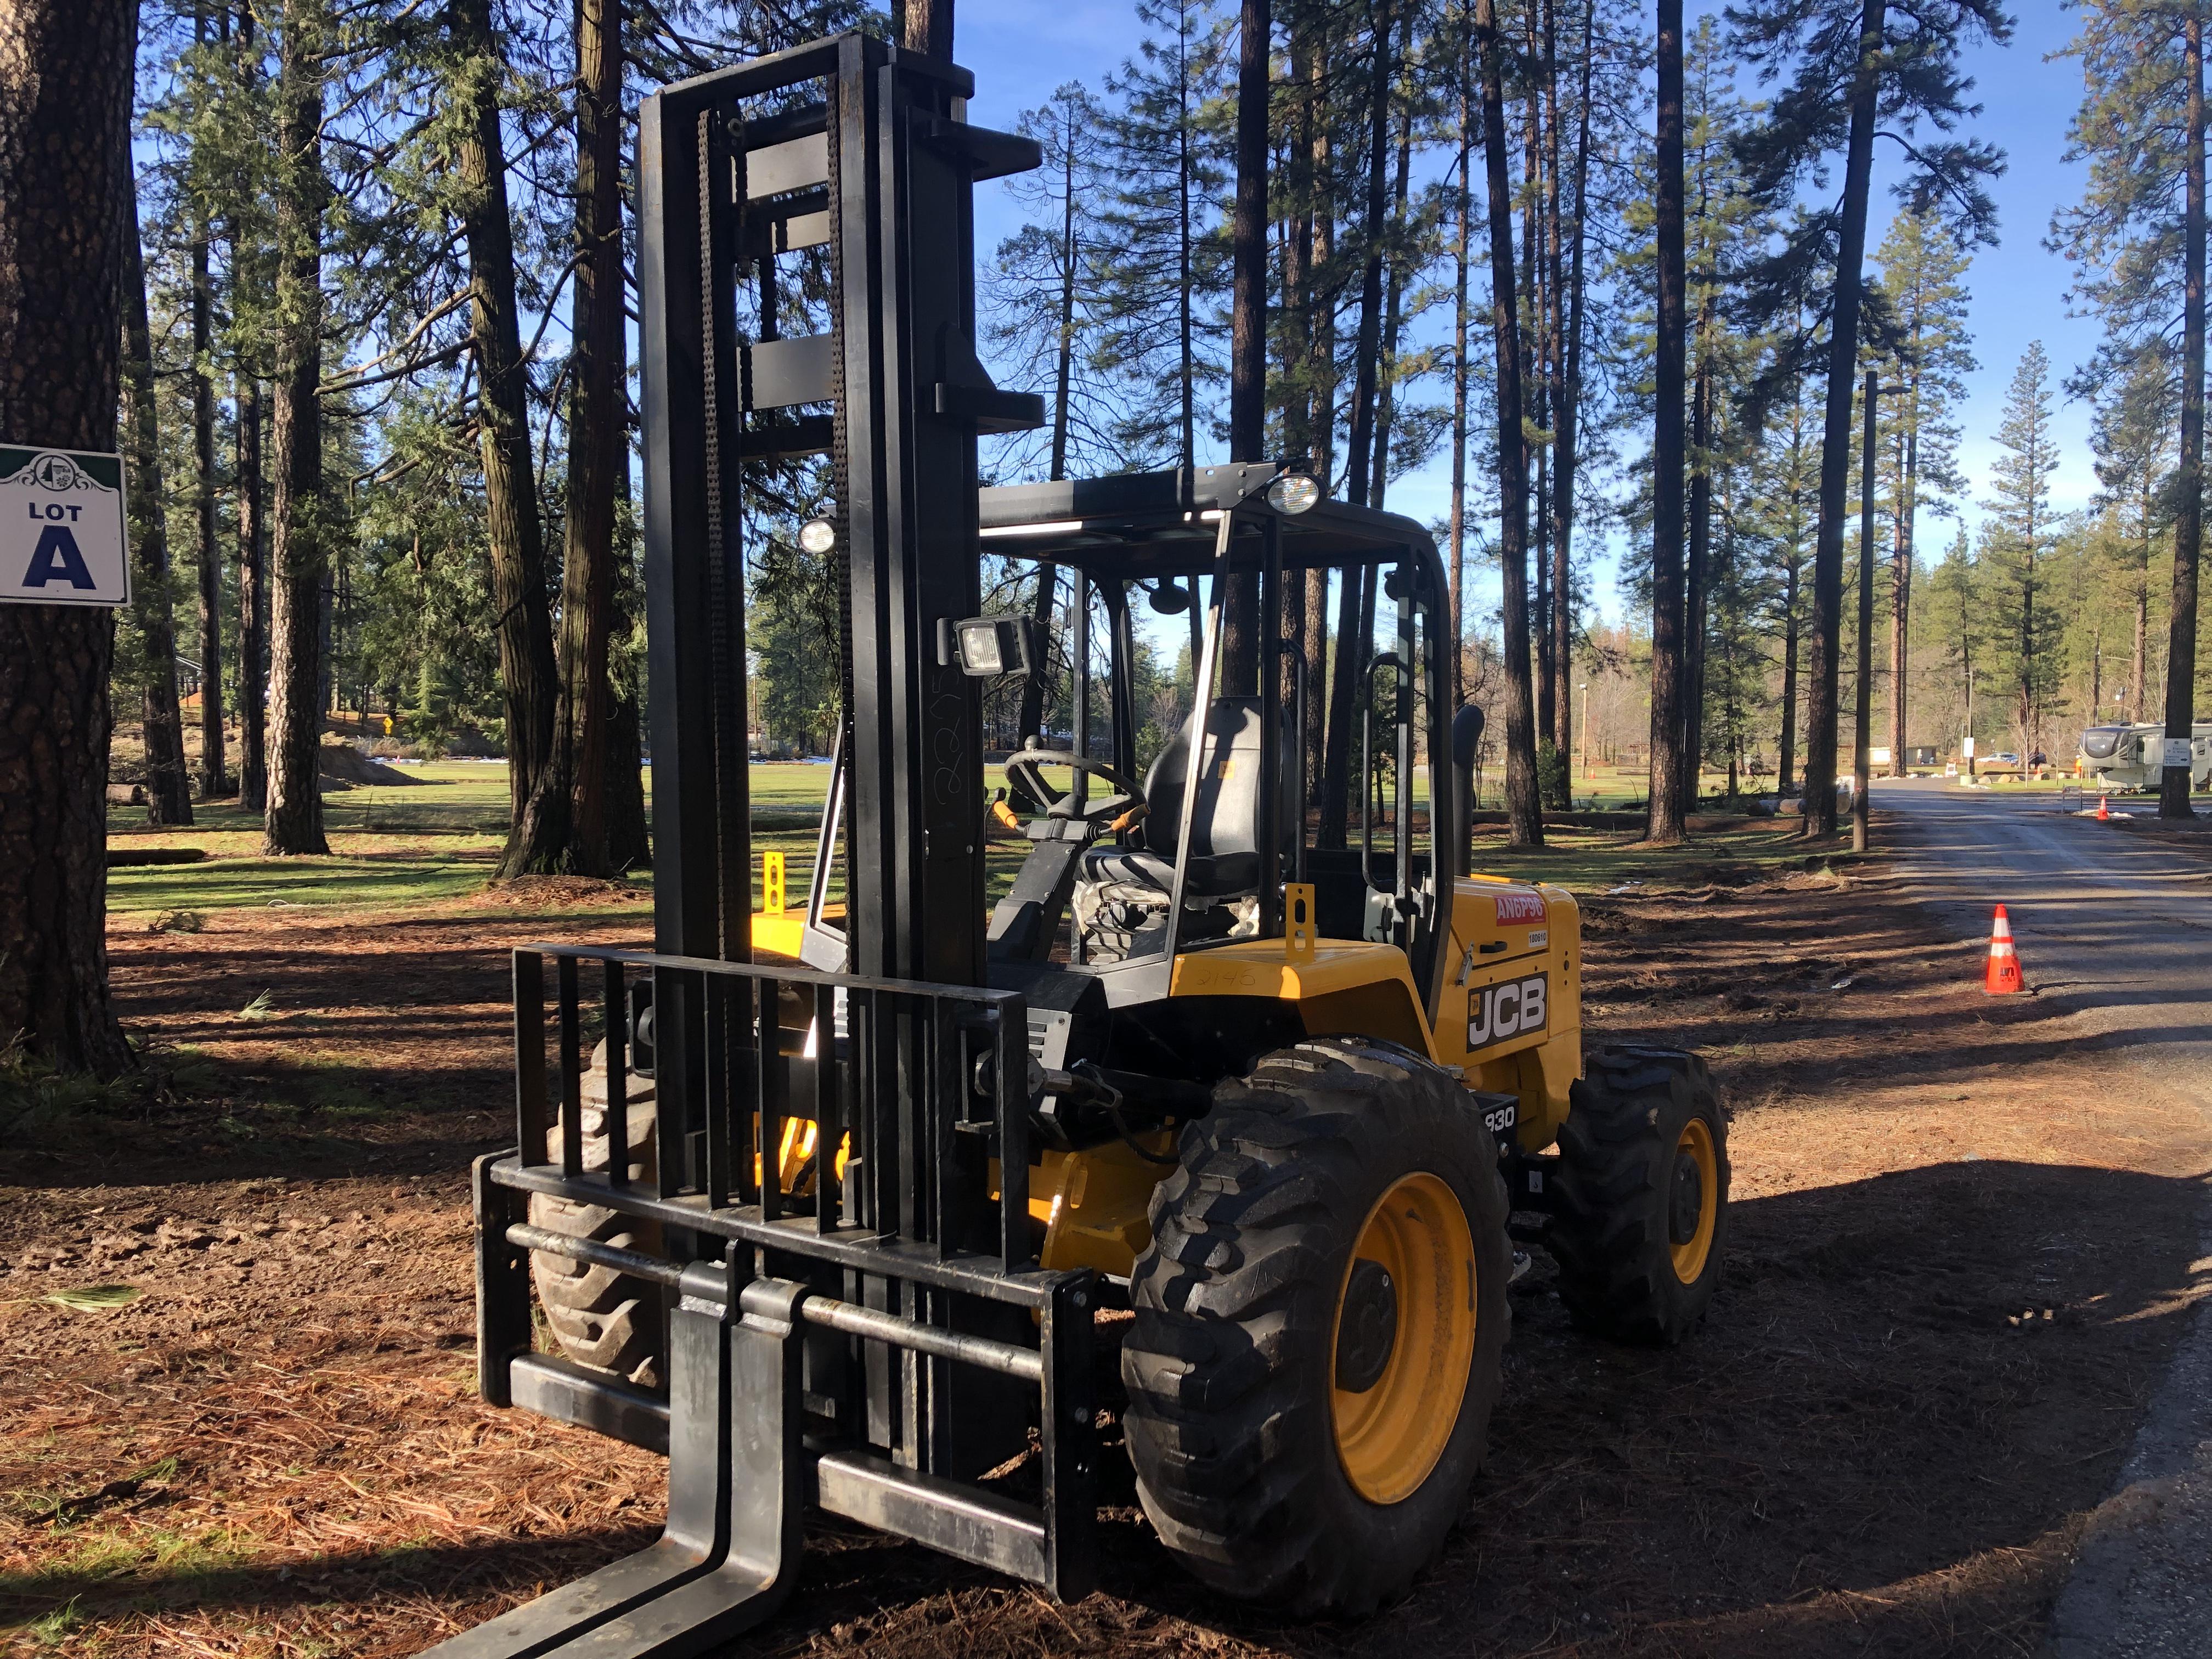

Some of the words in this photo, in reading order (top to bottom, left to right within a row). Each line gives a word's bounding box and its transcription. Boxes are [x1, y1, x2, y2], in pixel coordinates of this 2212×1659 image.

[29, 503, 82, 521] LOT
[22, 525, 97, 590] A
[1469, 978, 1545, 1045] JCB
[1485, 1106, 1515, 1133] 930
